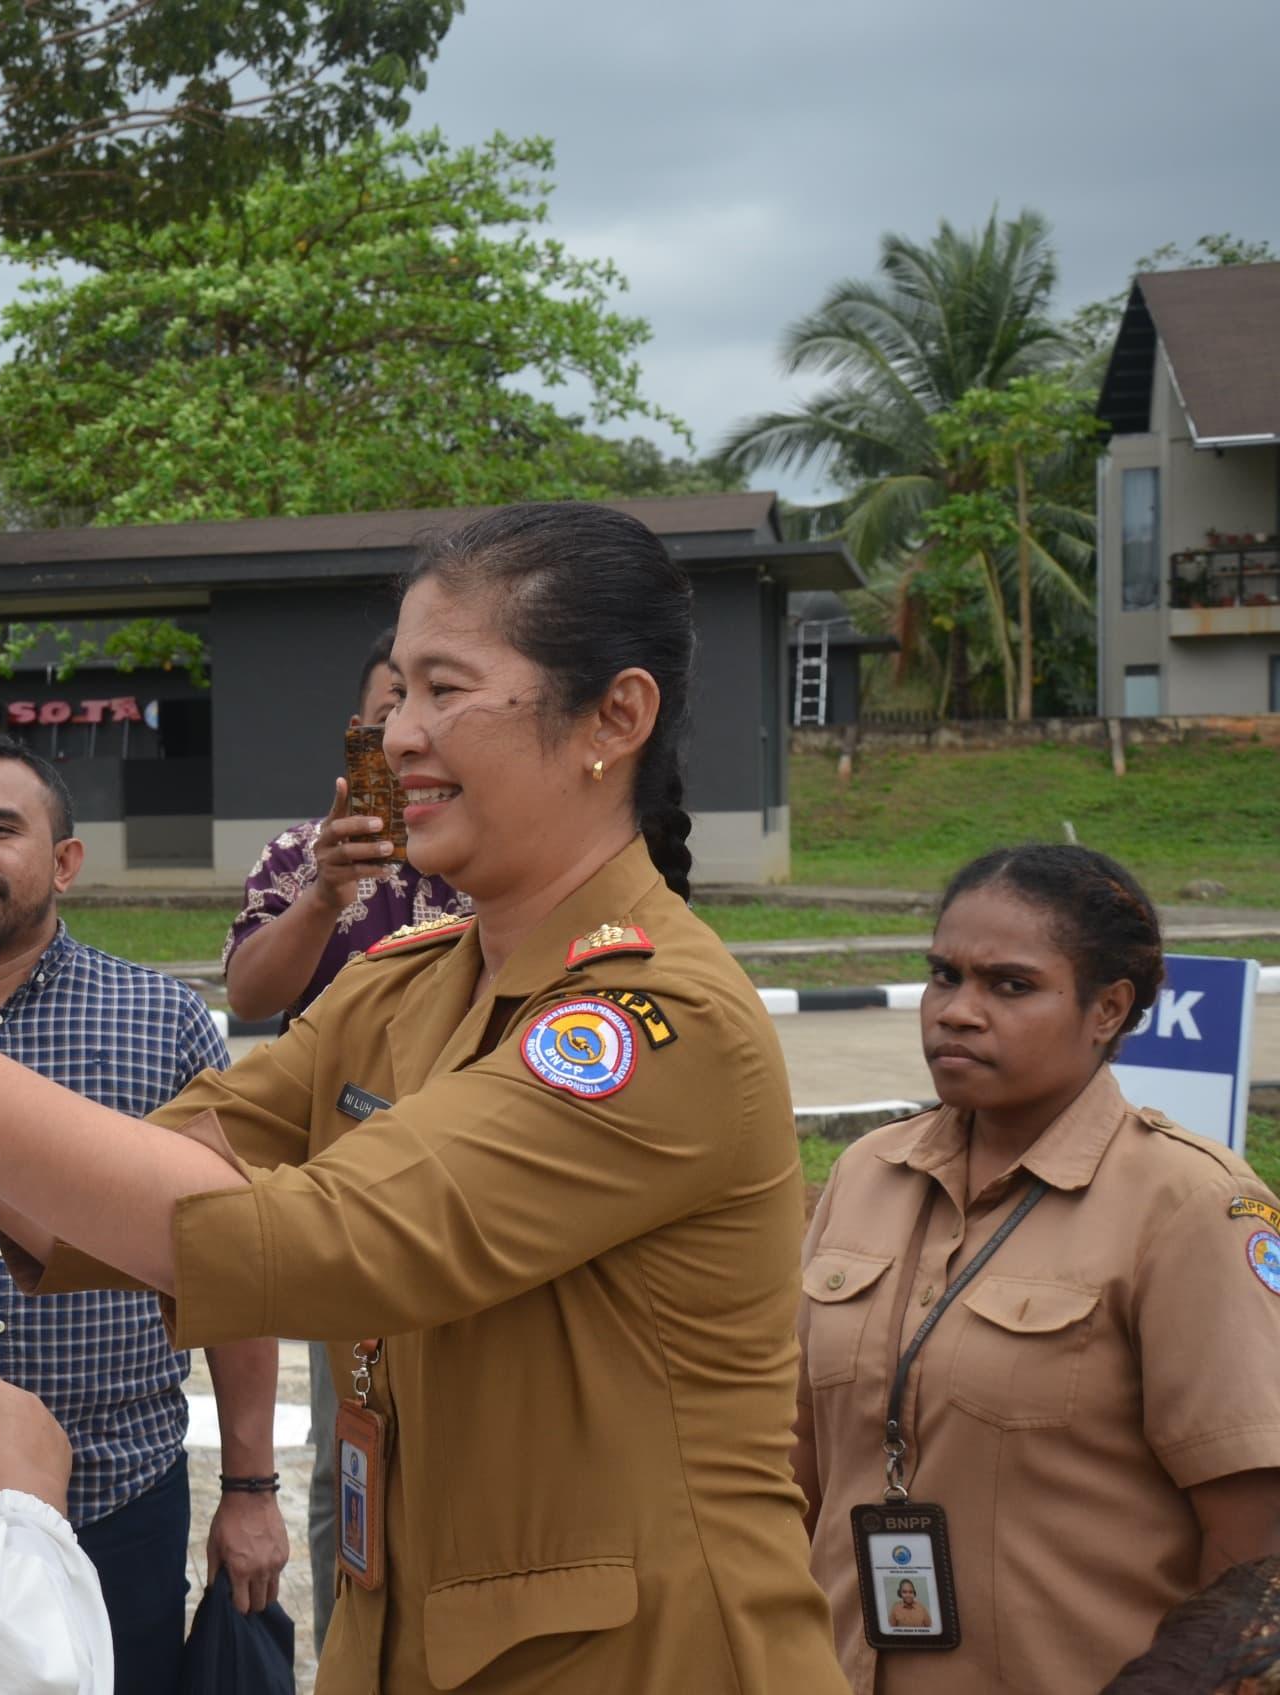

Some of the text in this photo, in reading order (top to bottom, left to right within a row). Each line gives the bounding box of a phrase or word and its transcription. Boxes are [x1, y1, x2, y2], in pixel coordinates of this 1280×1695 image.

[544, 1047, 584, 1076] BNPP
[547, 1071, 602, 1094] INDONESIA
[344, 1092, 372, 1113] NI LUH
[884, 1516, 932, 1530] BNPP
